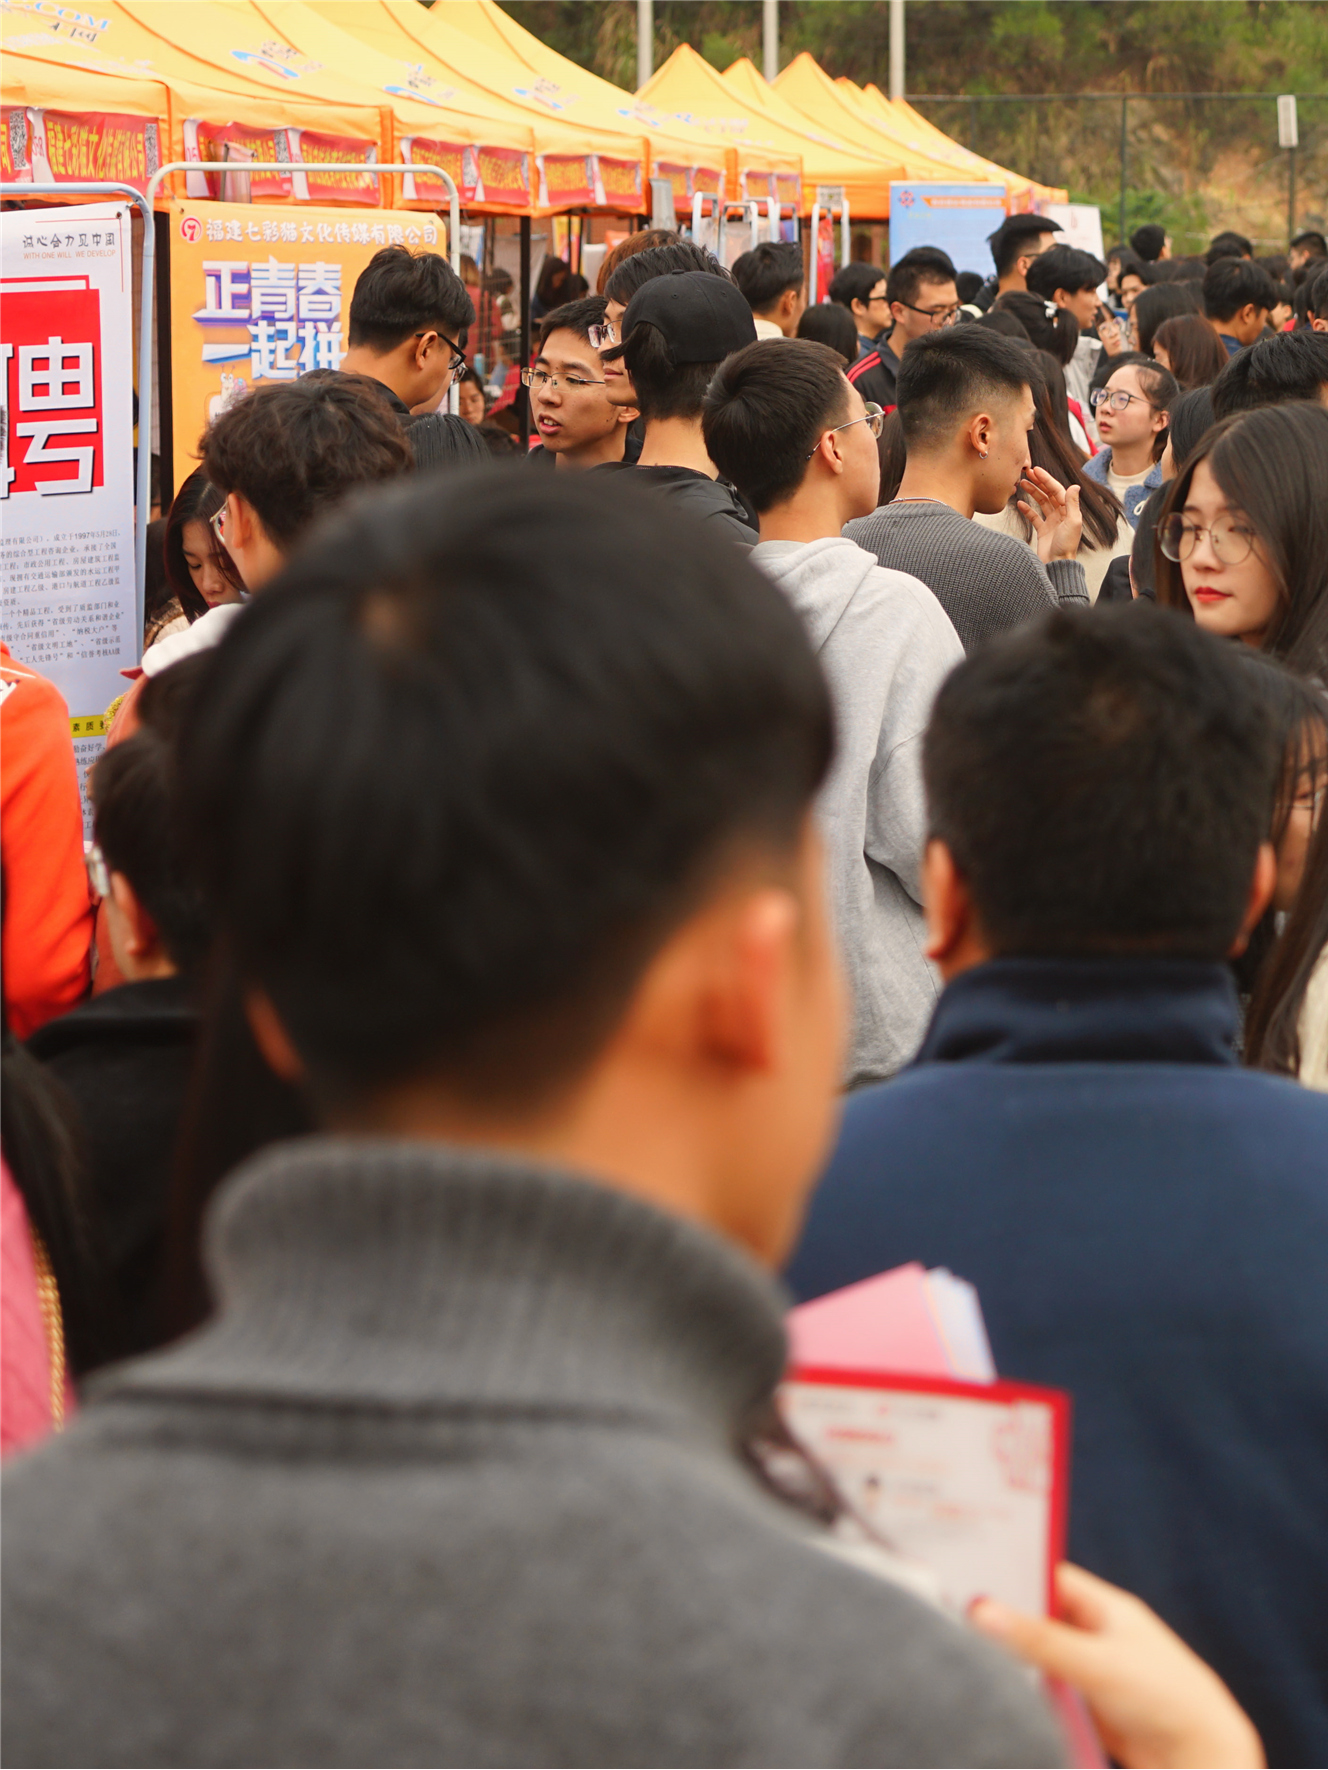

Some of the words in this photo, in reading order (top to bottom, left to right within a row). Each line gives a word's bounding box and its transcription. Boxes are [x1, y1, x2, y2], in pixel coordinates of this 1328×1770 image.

[206, 218, 438, 245] 福建七彩猫文化传媒有限公司
[42, 251, 55, 259] ONE
[57, 250, 71, 258] WILL
[87, 249, 116, 257] DEVELOP
[192, 255, 344, 322] 正青春
[202, 320, 347, 380] 一起拼
